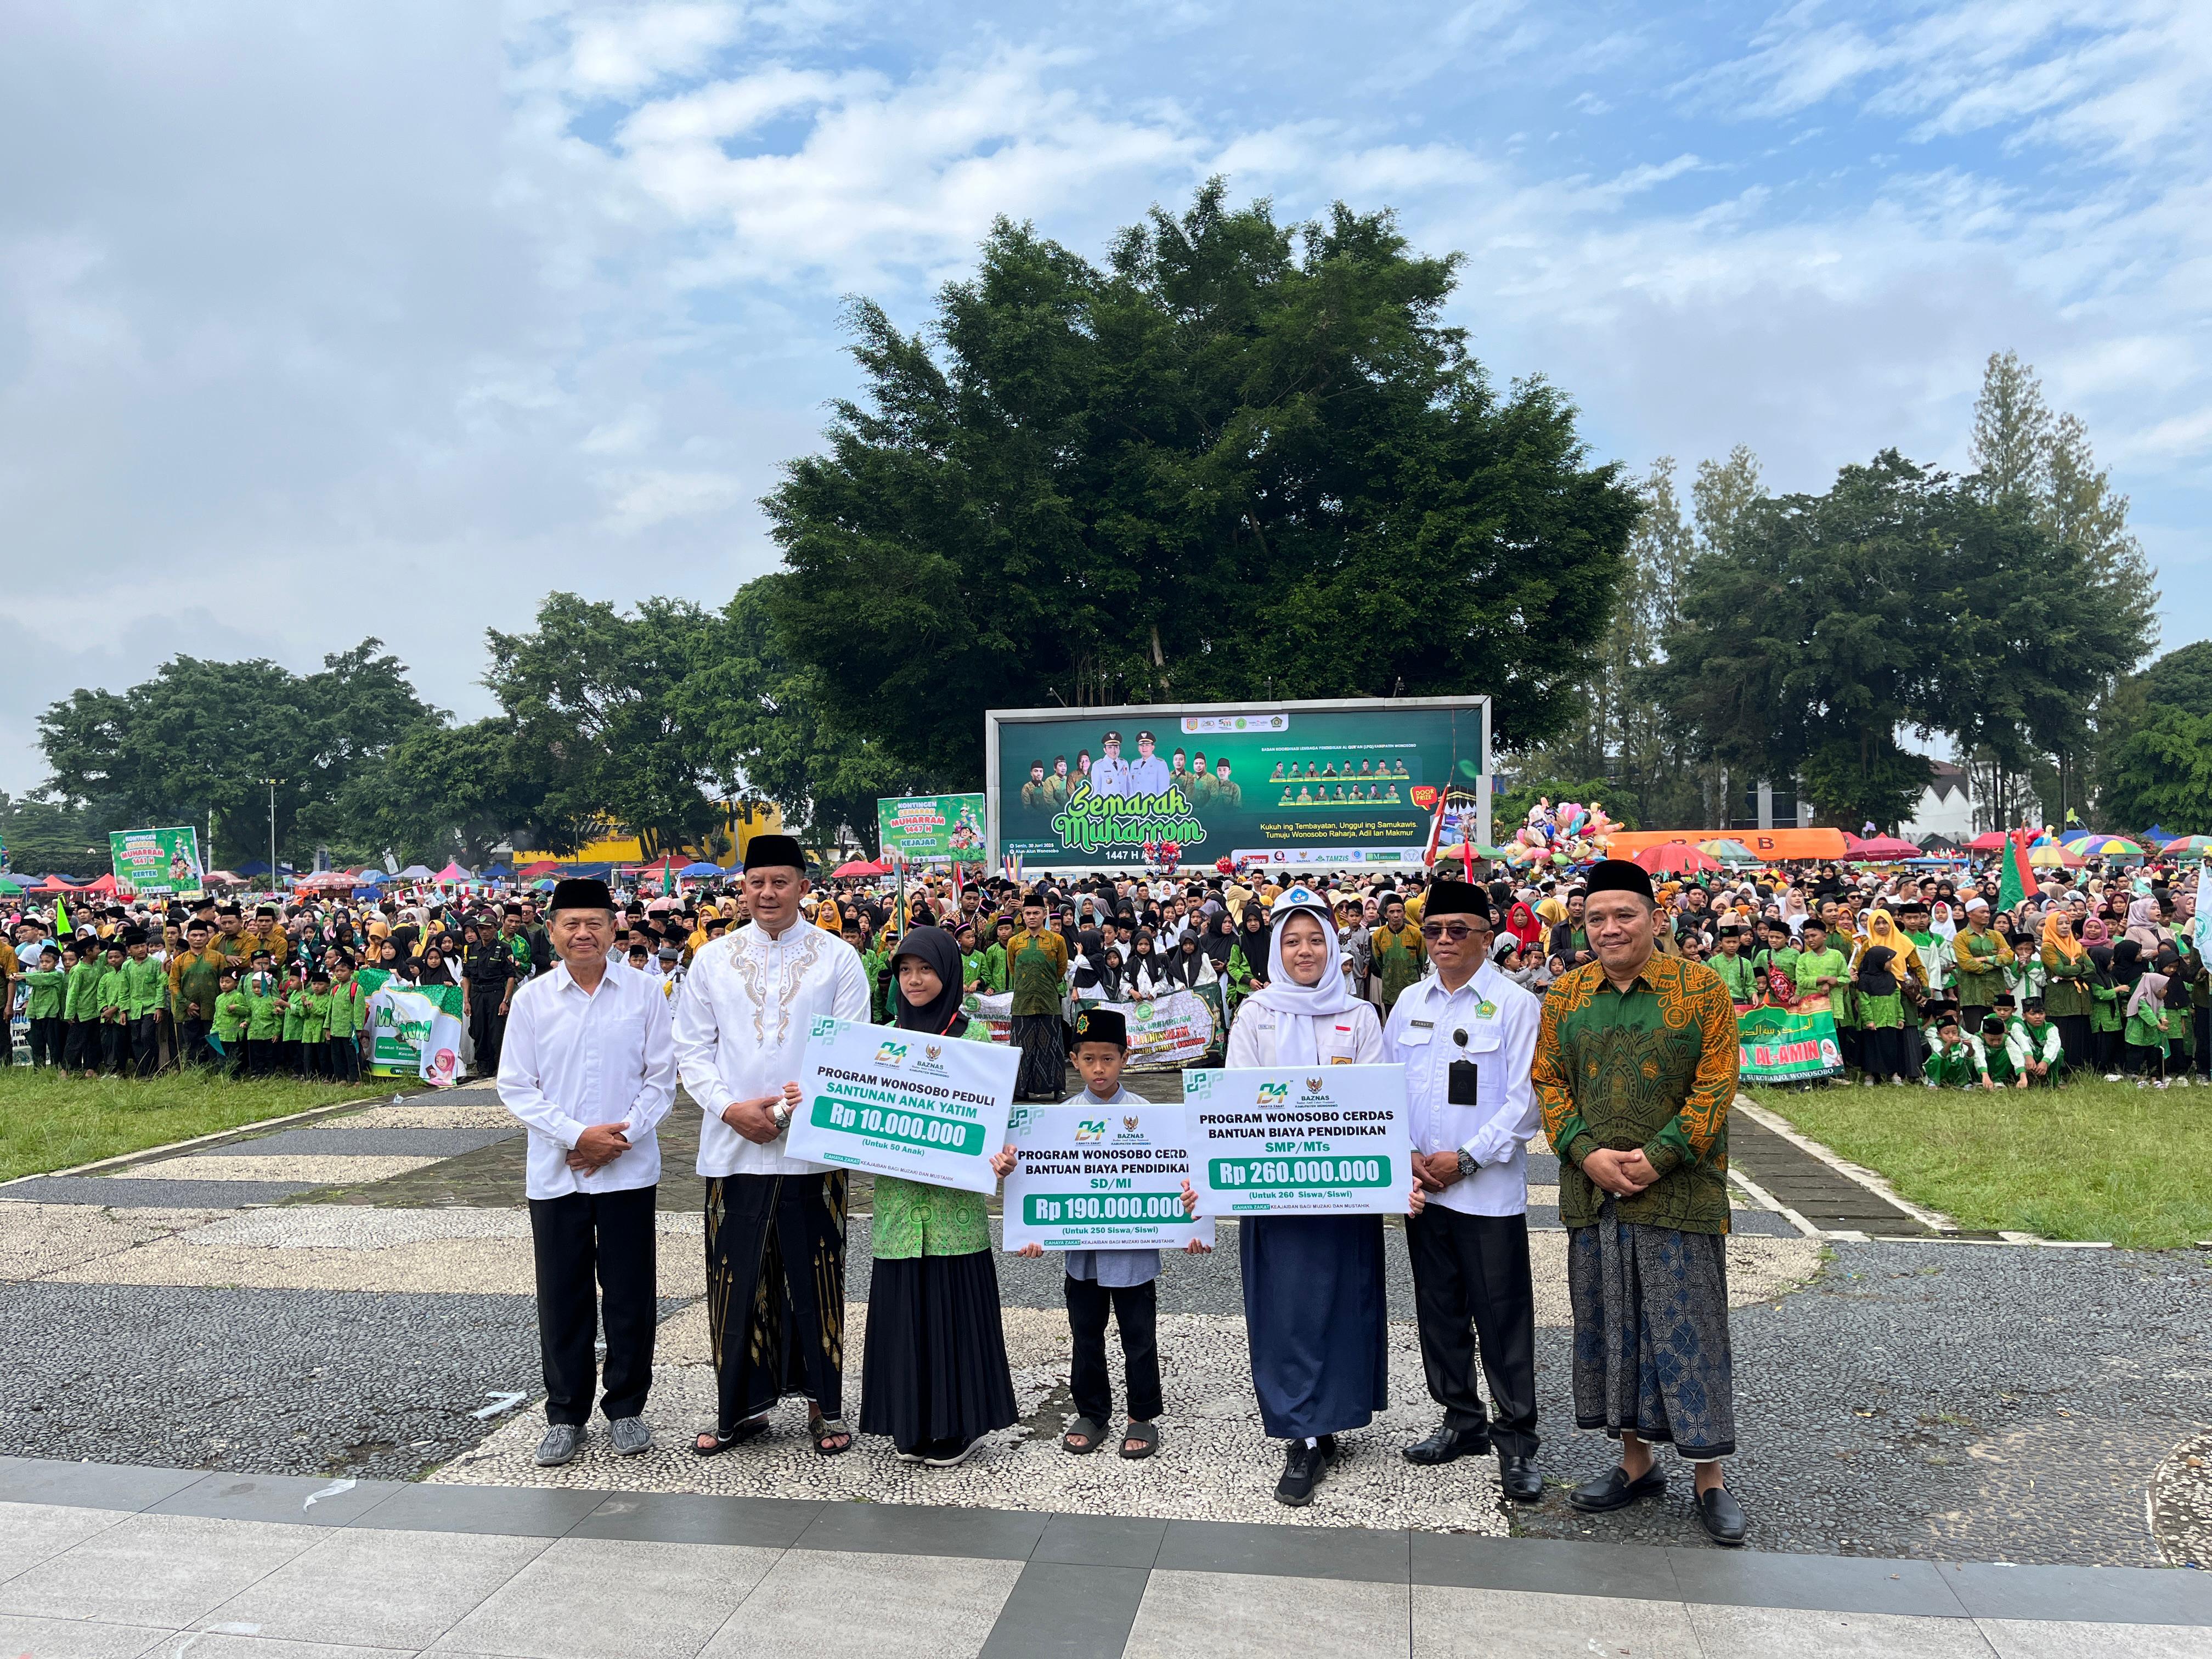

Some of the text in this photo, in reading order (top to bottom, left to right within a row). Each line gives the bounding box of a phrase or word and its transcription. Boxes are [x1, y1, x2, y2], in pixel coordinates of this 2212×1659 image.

[1067, 783, 1189, 817] Semarak
[898, 808, 935, 817] SEMARAK
[891, 816, 945, 827] MUHARRAM
[1054, 815, 1204, 851] Muharrom
[121, 850, 164, 859] MUHARRAM
[1105, 850, 1139, 860] 1447 H
[1147, 1015, 1192, 1030] MUHARRAM
[1755, 1039, 1820, 1066] AL-AMIN
[917, 1060, 944, 1070] BAZNAS
[1790, 1068, 1834, 1079] WONOSOBO
[817, 1066, 995, 1107] PROGRAM WONOSOBO PEDULI
[826, 1082, 978, 1119] SANTUNAN ANAK YATIM
[1200, 1110, 1394, 1124] PROGRAM WONOSOBO CERDAS
[830, 1102, 967, 1147] Rp 10.000.000
[1209, 1125, 1386, 1139] BANTUAN BIAYA PENDIDIKAN
[862, 1137, 925, 1157] (Untuk 50 Anak)
[1265, 1141, 1330, 1154] SMP/MTs
[1018, 1149, 1189, 1161] PROGRAM WONOSOBO CERD
[825, 1153, 843, 1162] CAHAYA
[860, 1160, 887, 1169] KEAJAIBAN
[900, 1167, 918, 1176] MUZAKI
[929, 1172, 954, 1182] MUSTAHIK
[1025, 1164, 1081, 1175] BANTUAN
[1084, 1164, 1118, 1173] BIAYA
[1219, 1160, 1379, 1186] Rp 260.000.000
[1090, 1178, 1132, 1190] SD/MI
[1249, 1191, 1277, 1200] (Untuk
[1298, 1190, 1352, 1198] Siswa/Siswi)
[1036, 1196, 1185, 1221] Rp 190.000.000
[1062, 1226, 1088, 1235] (Untuk
[1107, 1226, 1159, 1234] Siswa/Siswi)
